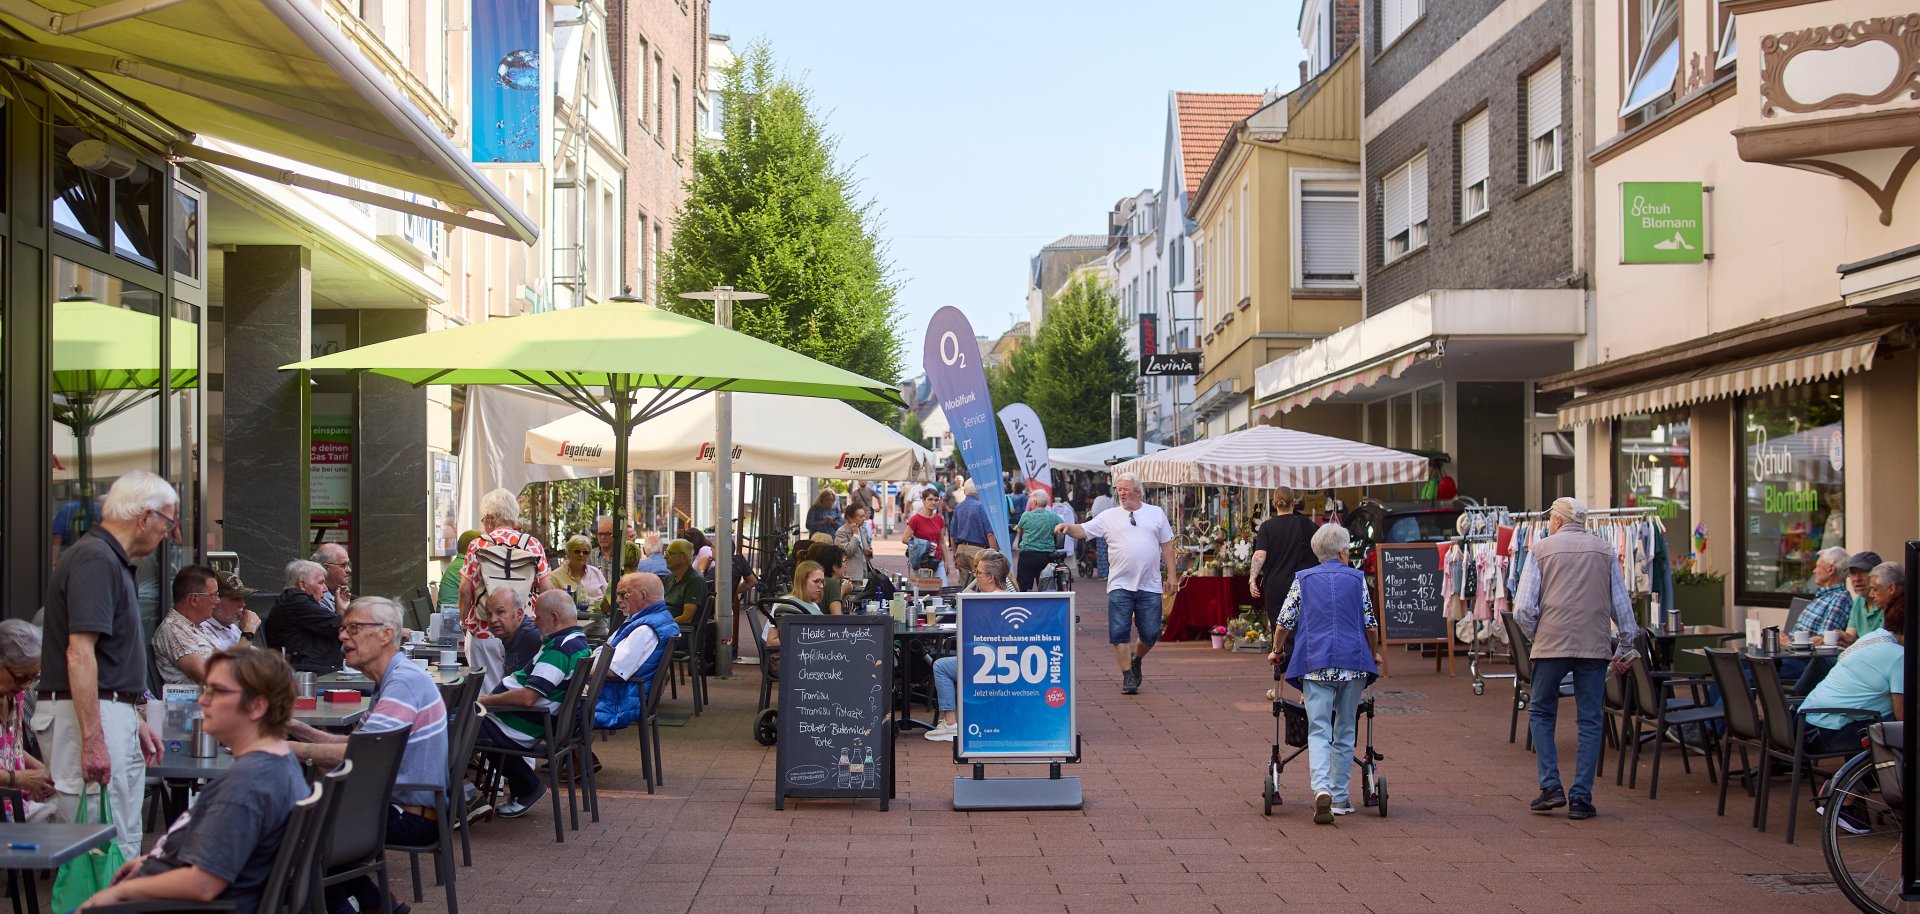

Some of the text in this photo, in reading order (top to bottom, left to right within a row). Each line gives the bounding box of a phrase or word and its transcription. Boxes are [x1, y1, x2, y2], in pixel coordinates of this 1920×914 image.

[1631, 195, 1671, 217] Schuh
[1642, 217, 1696, 229] Blomann
[1145, 355, 1193, 375] Lavinia
[944, 391, 976, 411] Mobilfunk
[963, 412, 986, 429] Service
[318, 443, 349, 452] deinen
[556, 440, 602, 458] Segafredo
[695, 441, 742, 461] Segdo
[1754, 424, 1793, 482] Schuh
[328, 452, 349, 461] Tarif
[834, 451, 882, 471] Segafredo
[1764, 484, 1818, 513] Blomann
[1385, 551, 1414, 562] Damen-
[1396, 562, 1422, 570] Schuhe
[1391, 587, 1408, 597] Paar
[1386, 599, 1396, 609] Ab
[1397, 600, 1413, 610] dem
[1421, 600, 1438, 612] Paar
[801, 627, 873, 644] Heute im Angebot
[1030, 634, 1041, 642] mit
[798, 649, 850, 665] Apfelkuchen
[973, 645, 1048, 684] 250
[1050, 645, 1063, 683] MBit/s
[798, 668, 843, 681] Cheesecake
[988, 689, 1011, 697] einfach
[811, 735, 835, 749] Torte
